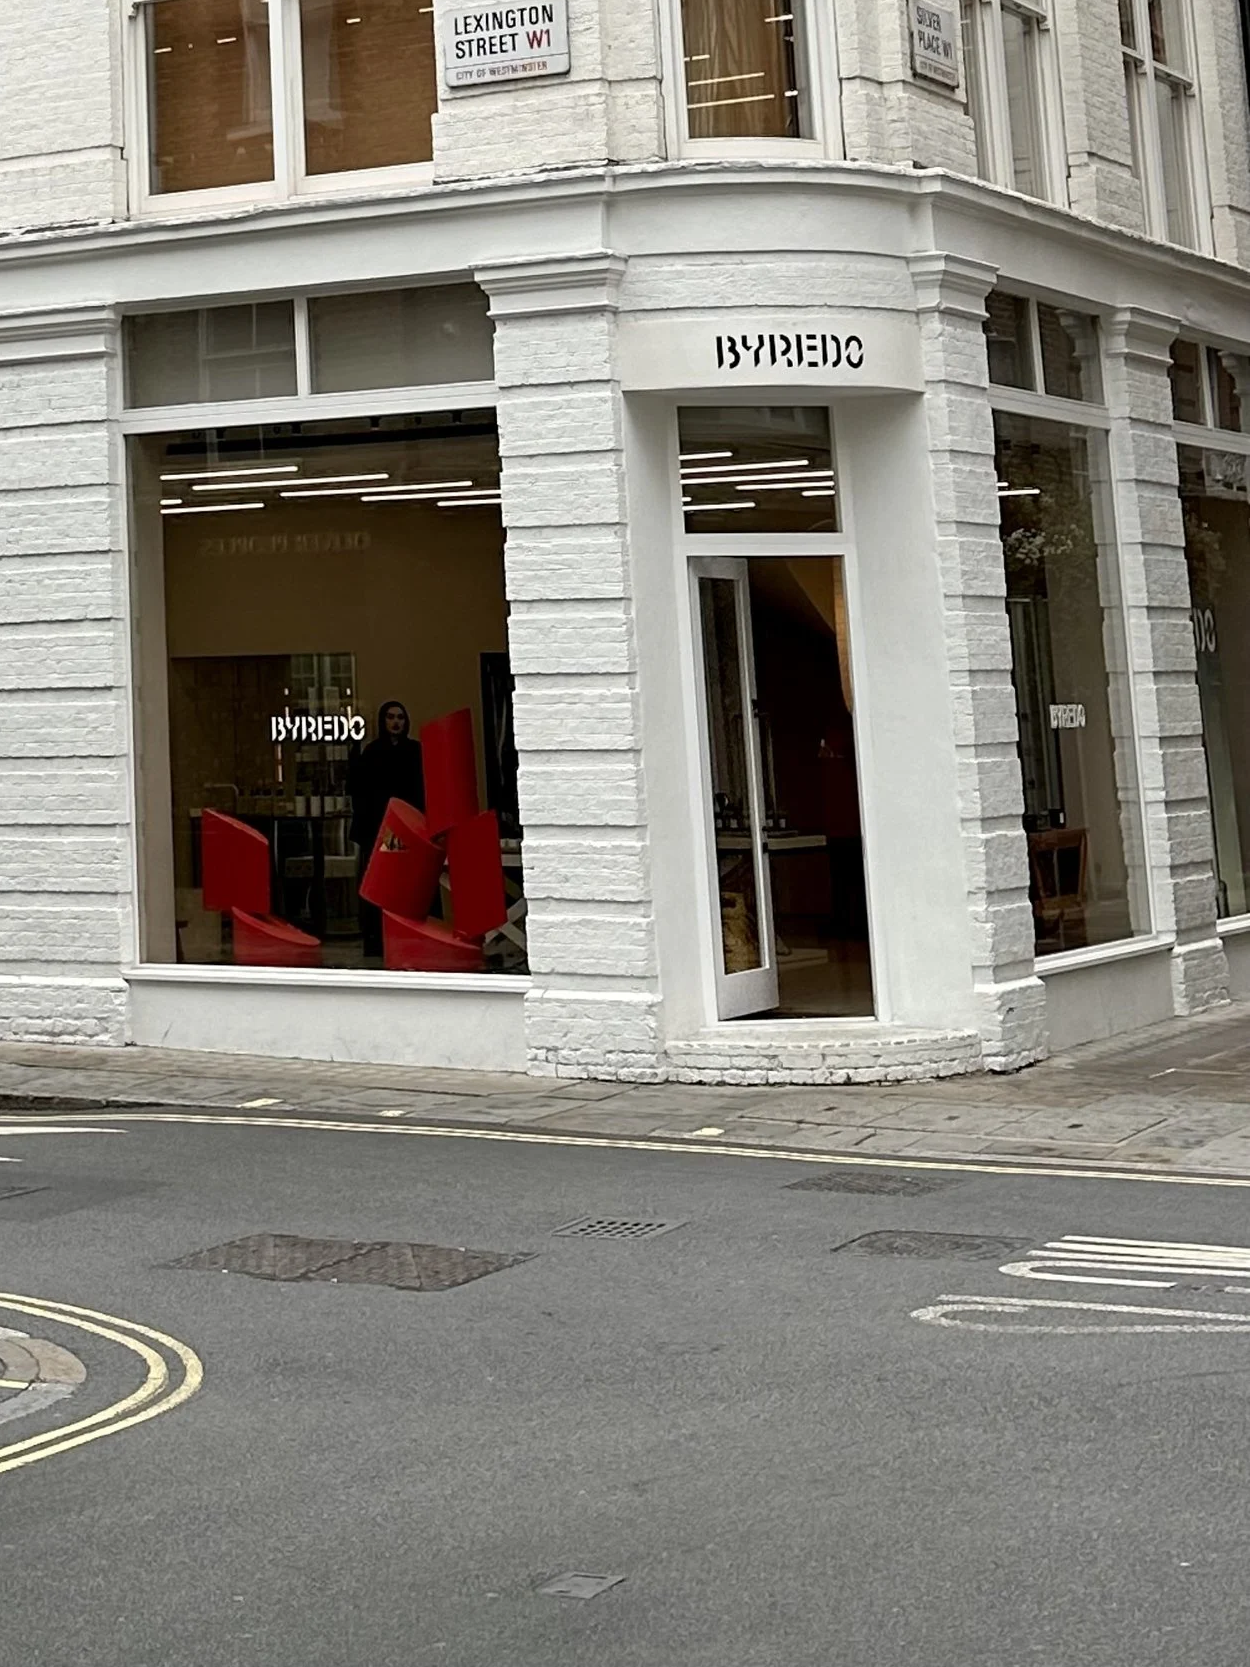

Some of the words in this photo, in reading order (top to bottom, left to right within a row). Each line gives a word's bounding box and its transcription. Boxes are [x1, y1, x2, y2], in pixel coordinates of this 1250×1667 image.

[454, 4, 554, 36] LEXINGTON
[916, 6, 942, 33] SILVER
[455, 33, 518, 59] STREET
[526, 29, 551, 50] W1
[918, 30, 941, 56] PLACE
[942, 40, 953, 60] W1
[456, 69, 473, 81] CITY
[477, 67, 486, 78] OF
[489, 61, 548, 77] WESTMINSTER
[715, 334, 864, 369] BYREDO
[271, 715, 365, 742] BYREDO
[1049, 704, 1086, 729] BYREDO
